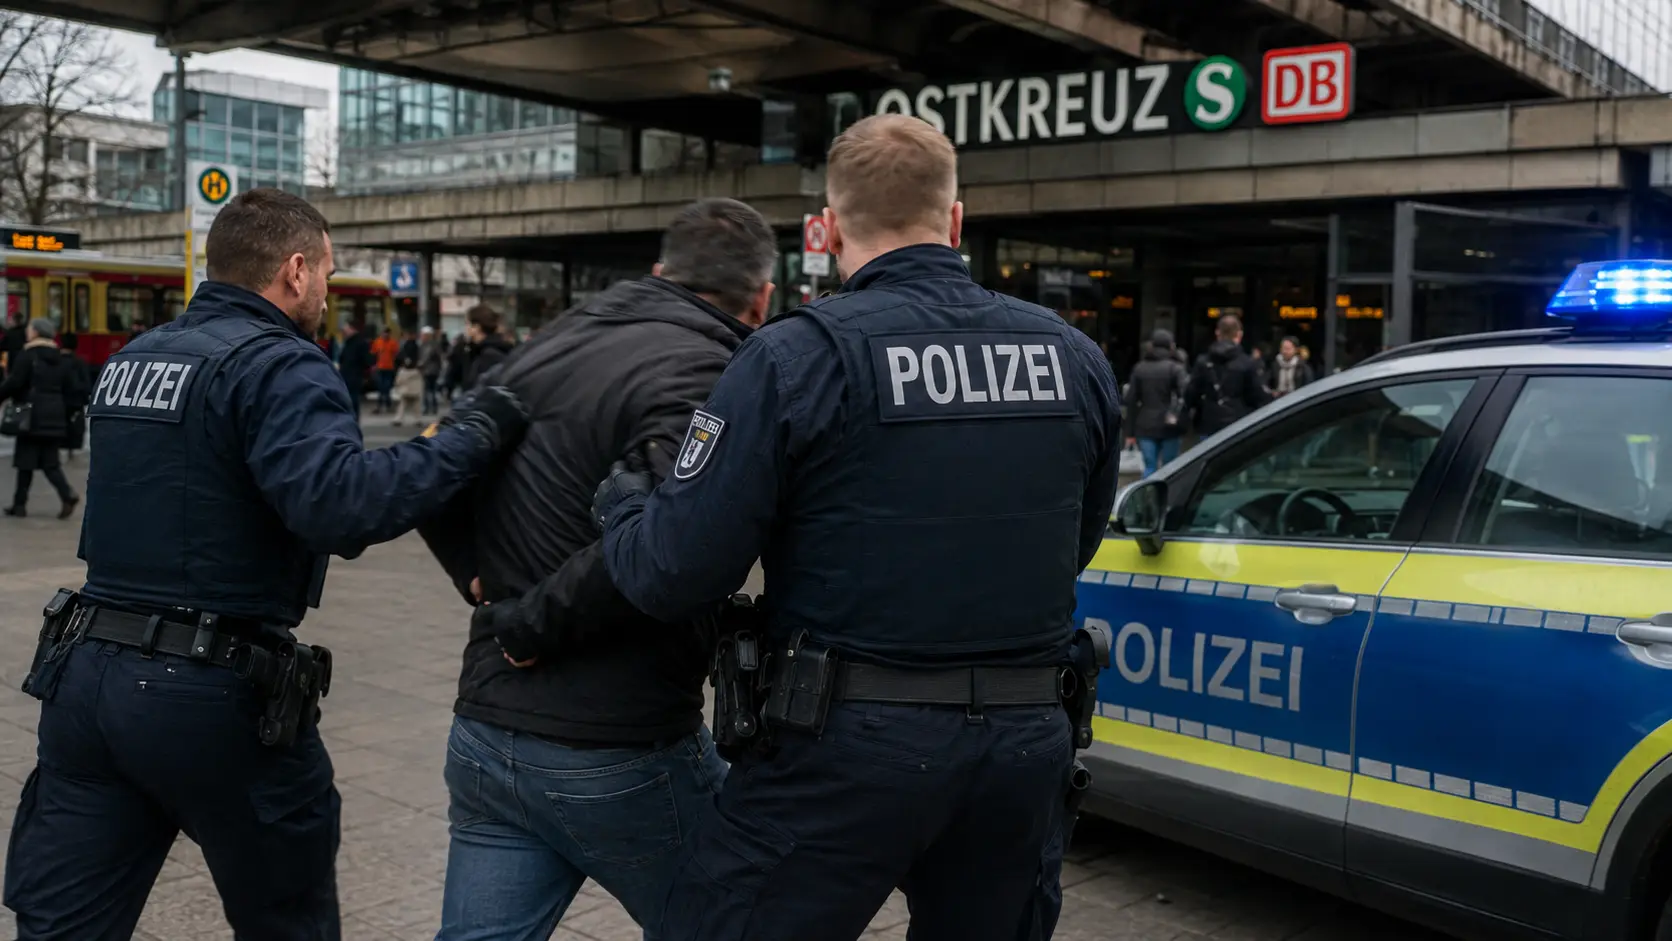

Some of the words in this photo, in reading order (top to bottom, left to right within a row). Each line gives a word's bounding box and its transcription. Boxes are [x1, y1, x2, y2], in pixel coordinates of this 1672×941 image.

[1194, 61, 1235, 122] S
[1275, 58, 1338, 109] DB
[92, 360, 192, 411] POLIZEI
[886, 344, 1067, 406] POLIZEI
